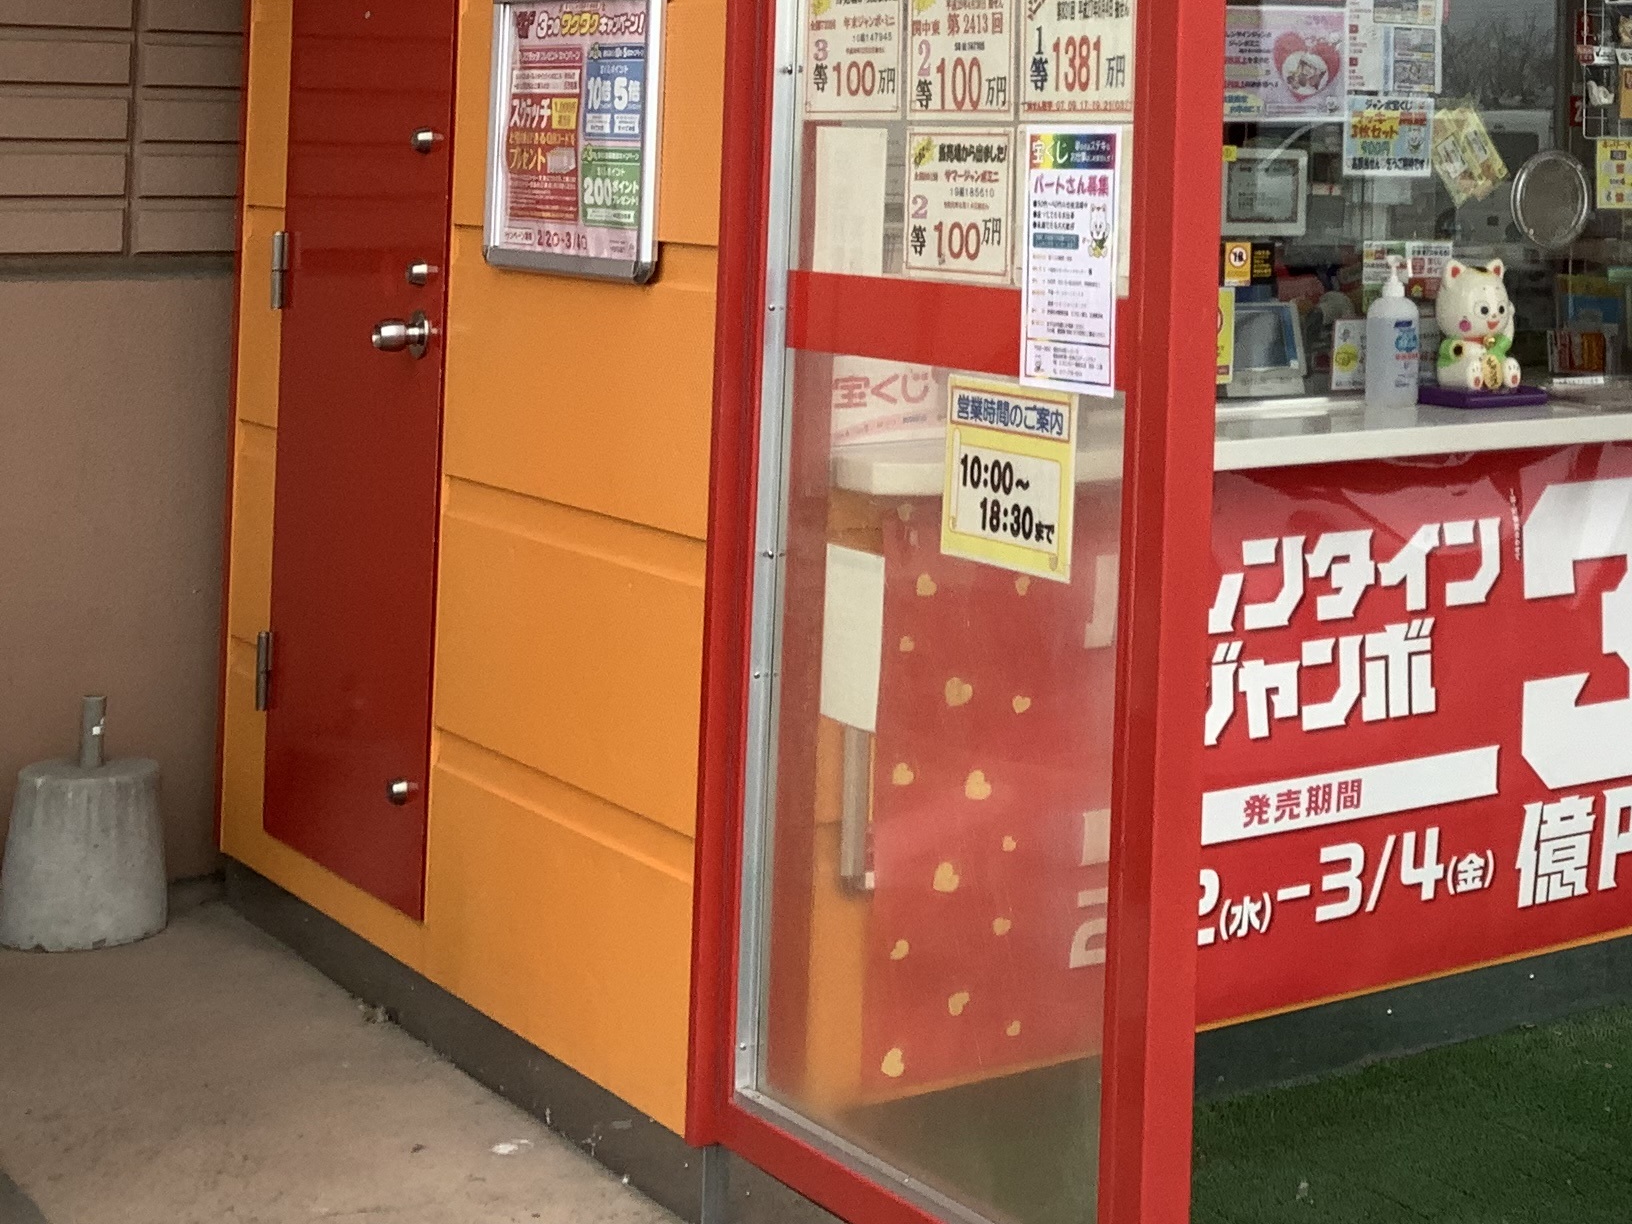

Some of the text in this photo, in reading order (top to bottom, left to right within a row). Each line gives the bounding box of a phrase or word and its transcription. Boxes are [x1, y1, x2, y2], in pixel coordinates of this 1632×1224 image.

[1032, 139, 1069, 164] 宝くじ
[956, 394, 1065, 437] 営業時間のご案内
[980, 497, 1055, 544] 18:30まで
[1242, 778, 1364, 830] 発売期間
